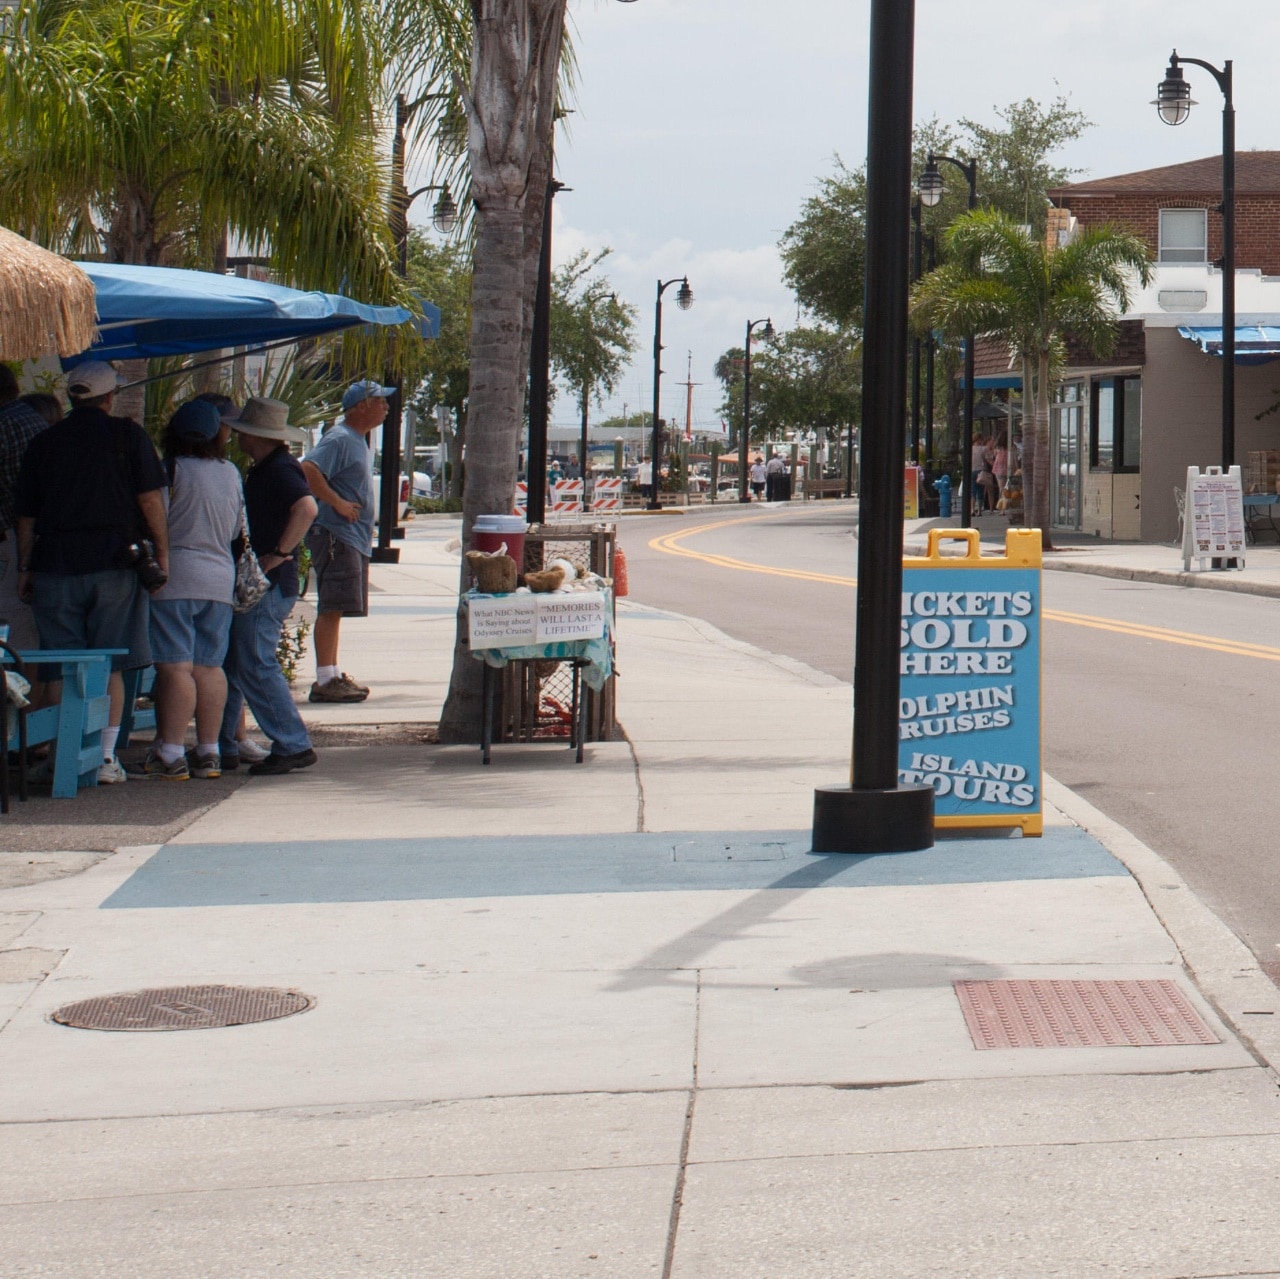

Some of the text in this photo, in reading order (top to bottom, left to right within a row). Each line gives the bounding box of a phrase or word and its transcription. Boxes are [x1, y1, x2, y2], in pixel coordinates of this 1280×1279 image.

[474, 608, 534, 618] What NBC News
[902, 591, 1032, 617] ICKETS
[485, 619, 510, 630] Saying
[511, 618, 532, 626] about
[540, 613, 602, 624] WILL LAST A
[474, 627, 533, 638] Odyssey Cruises
[900, 651, 1013, 675] HERE
[900, 685, 1014, 720] OLPHIN
[900, 709, 1011, 740] RUISES
[910, 752, 1026, 783] ISLAND
